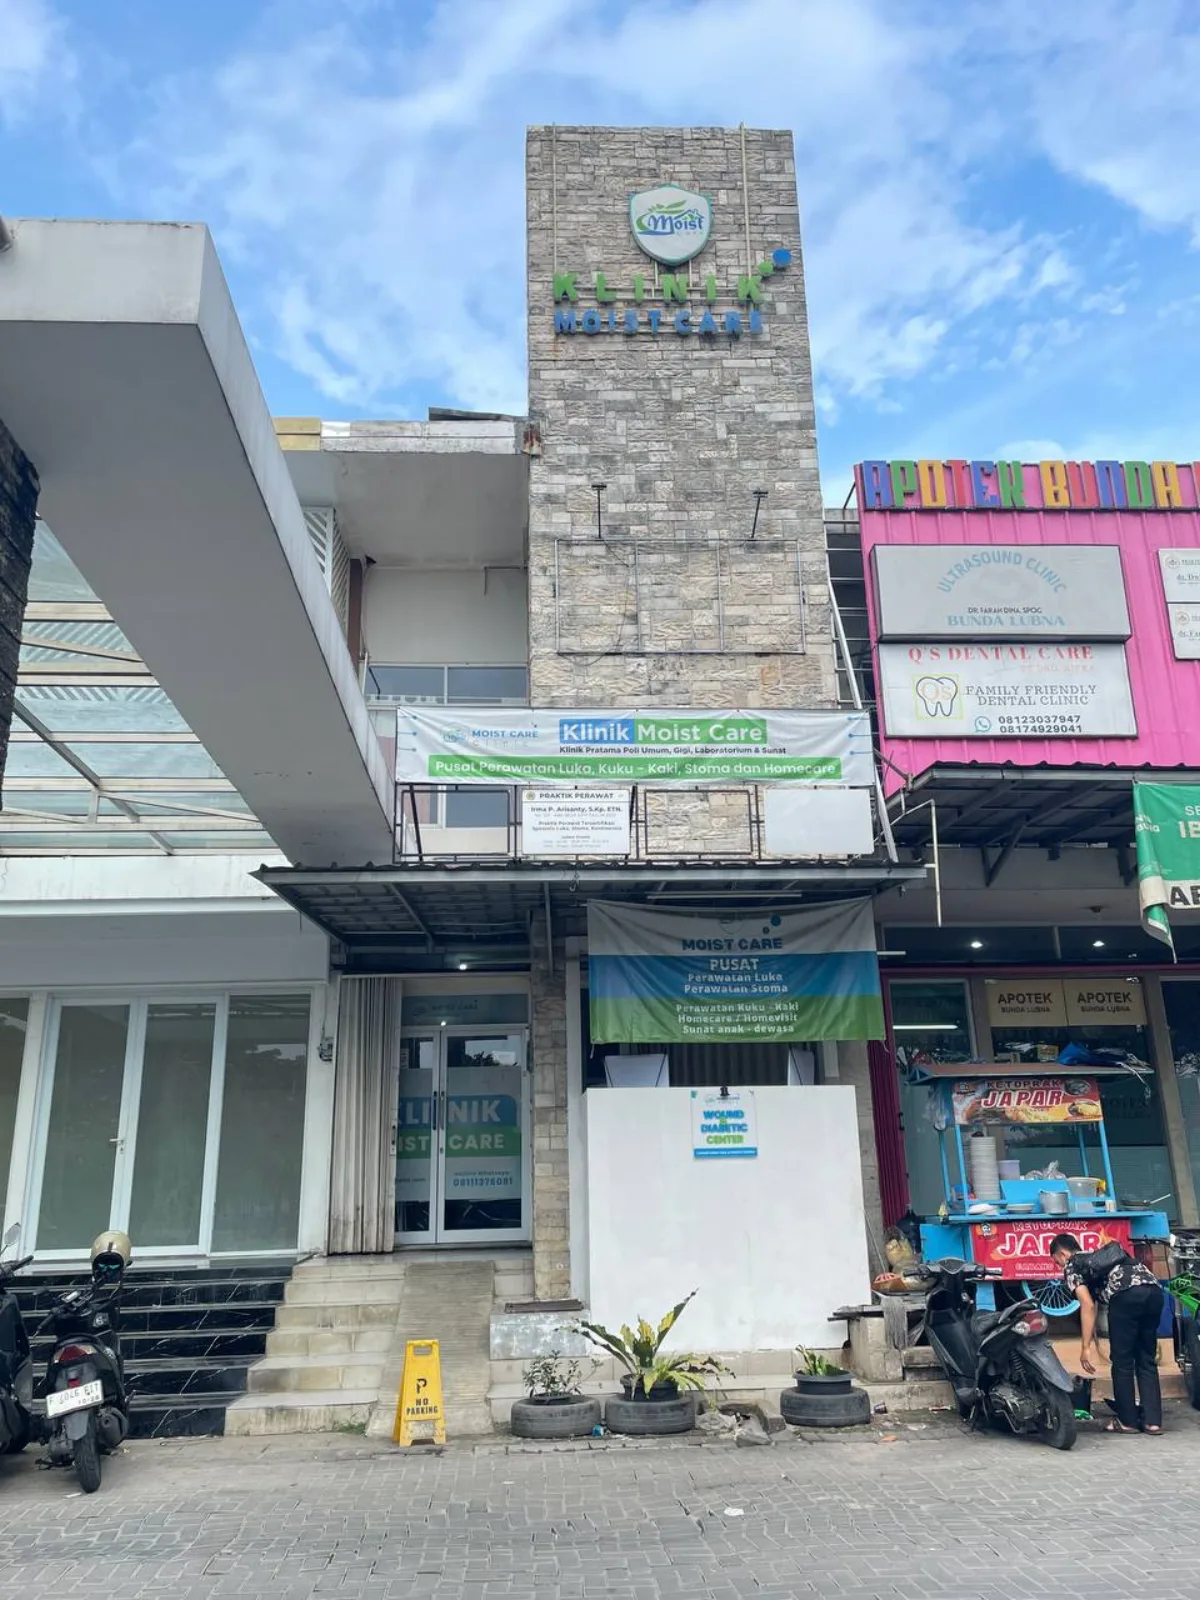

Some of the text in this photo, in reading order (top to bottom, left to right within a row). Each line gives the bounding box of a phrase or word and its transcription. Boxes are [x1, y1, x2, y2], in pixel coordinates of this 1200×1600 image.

[554, 271, 764, 304] KLINIK
[554, 309, 763, 337] MOIST CARE
[862, 459, 1027, 509] APOTEK
[1039, 459, 1183, 509] BUNDA
[937, 550, 1067, 594] ULTRASOUND CLINIC
[947, 615, 1066, 626] BUNDA LUBNA
[908, 645, 1094, 664] Q'S DENTAL CARE
[966, 684, 1097, 696] FAMILY FRIENDLY
[978, 694, 1089, 706] DENTAL CLINIC
[998, 714, 1081, 724] 08123037947
[472, 729, 539, 738] MOIST CARE
[563, 723, 763, 742] Klinik Moist Care
[999, 724, 1083, 733] 08174929041
[623, 746, 639, 754] Poli
[641, 747, 671, 755] Umum,
[673, 747, 693, 755] Gigi,
[435, 760, 476, 772] Pusat
[479, 760, 556, 773] Perawatan
[559, 763, 595, 775] Luka,
[599, 763, 633, 774] Kuku
[648, 763, 681, 775] Kaki,
[684, 763, 730, 774] Stoma
[734, 763, 760, 774] dan
[764, 763, 836, 774] Homecare
[682, 938, 783, 951] MOIST CARE
[710, 958, 759, 971] PUSAT
[688, 972, 783, 982] Perawatan Luka
[684, 984, 788, 993] Perawatan Stoma
[998, 992, 1053, 1004] APOTEK
[1077, 991, 1132, 1004] APOTEK
[676, 1003, 735, 1013] Perawatan
[738, 1003, 765, 1011] Kuku
[774, 1001, 799, 1011] Kaki
[678, 1014, 732, 1023] Homecare
[742, 1012, 798, 1022] Homevisit
[683, 1025, 716, 1034] Sunat
[718, 1025, 744, 1033] anak
[754, 1023, 794, 1033] dewasa
[986, 1079, 1063, 1090] KETOPRAK
[980, 1089, 1065, 1108] JAPAR
[703, 1109, 745, 1119] WOUND
[700, 1123, 748, 1133] DIABETIC
[449, 1133, 505, 1150] CARE
[706, 1134, 744, 1144] CENTER
[1012, 1220, 1088, 1232] KETOPRAK
[415, 1398, 429, 1406] NO
[406, 1405, 439, 1416] PARKING
